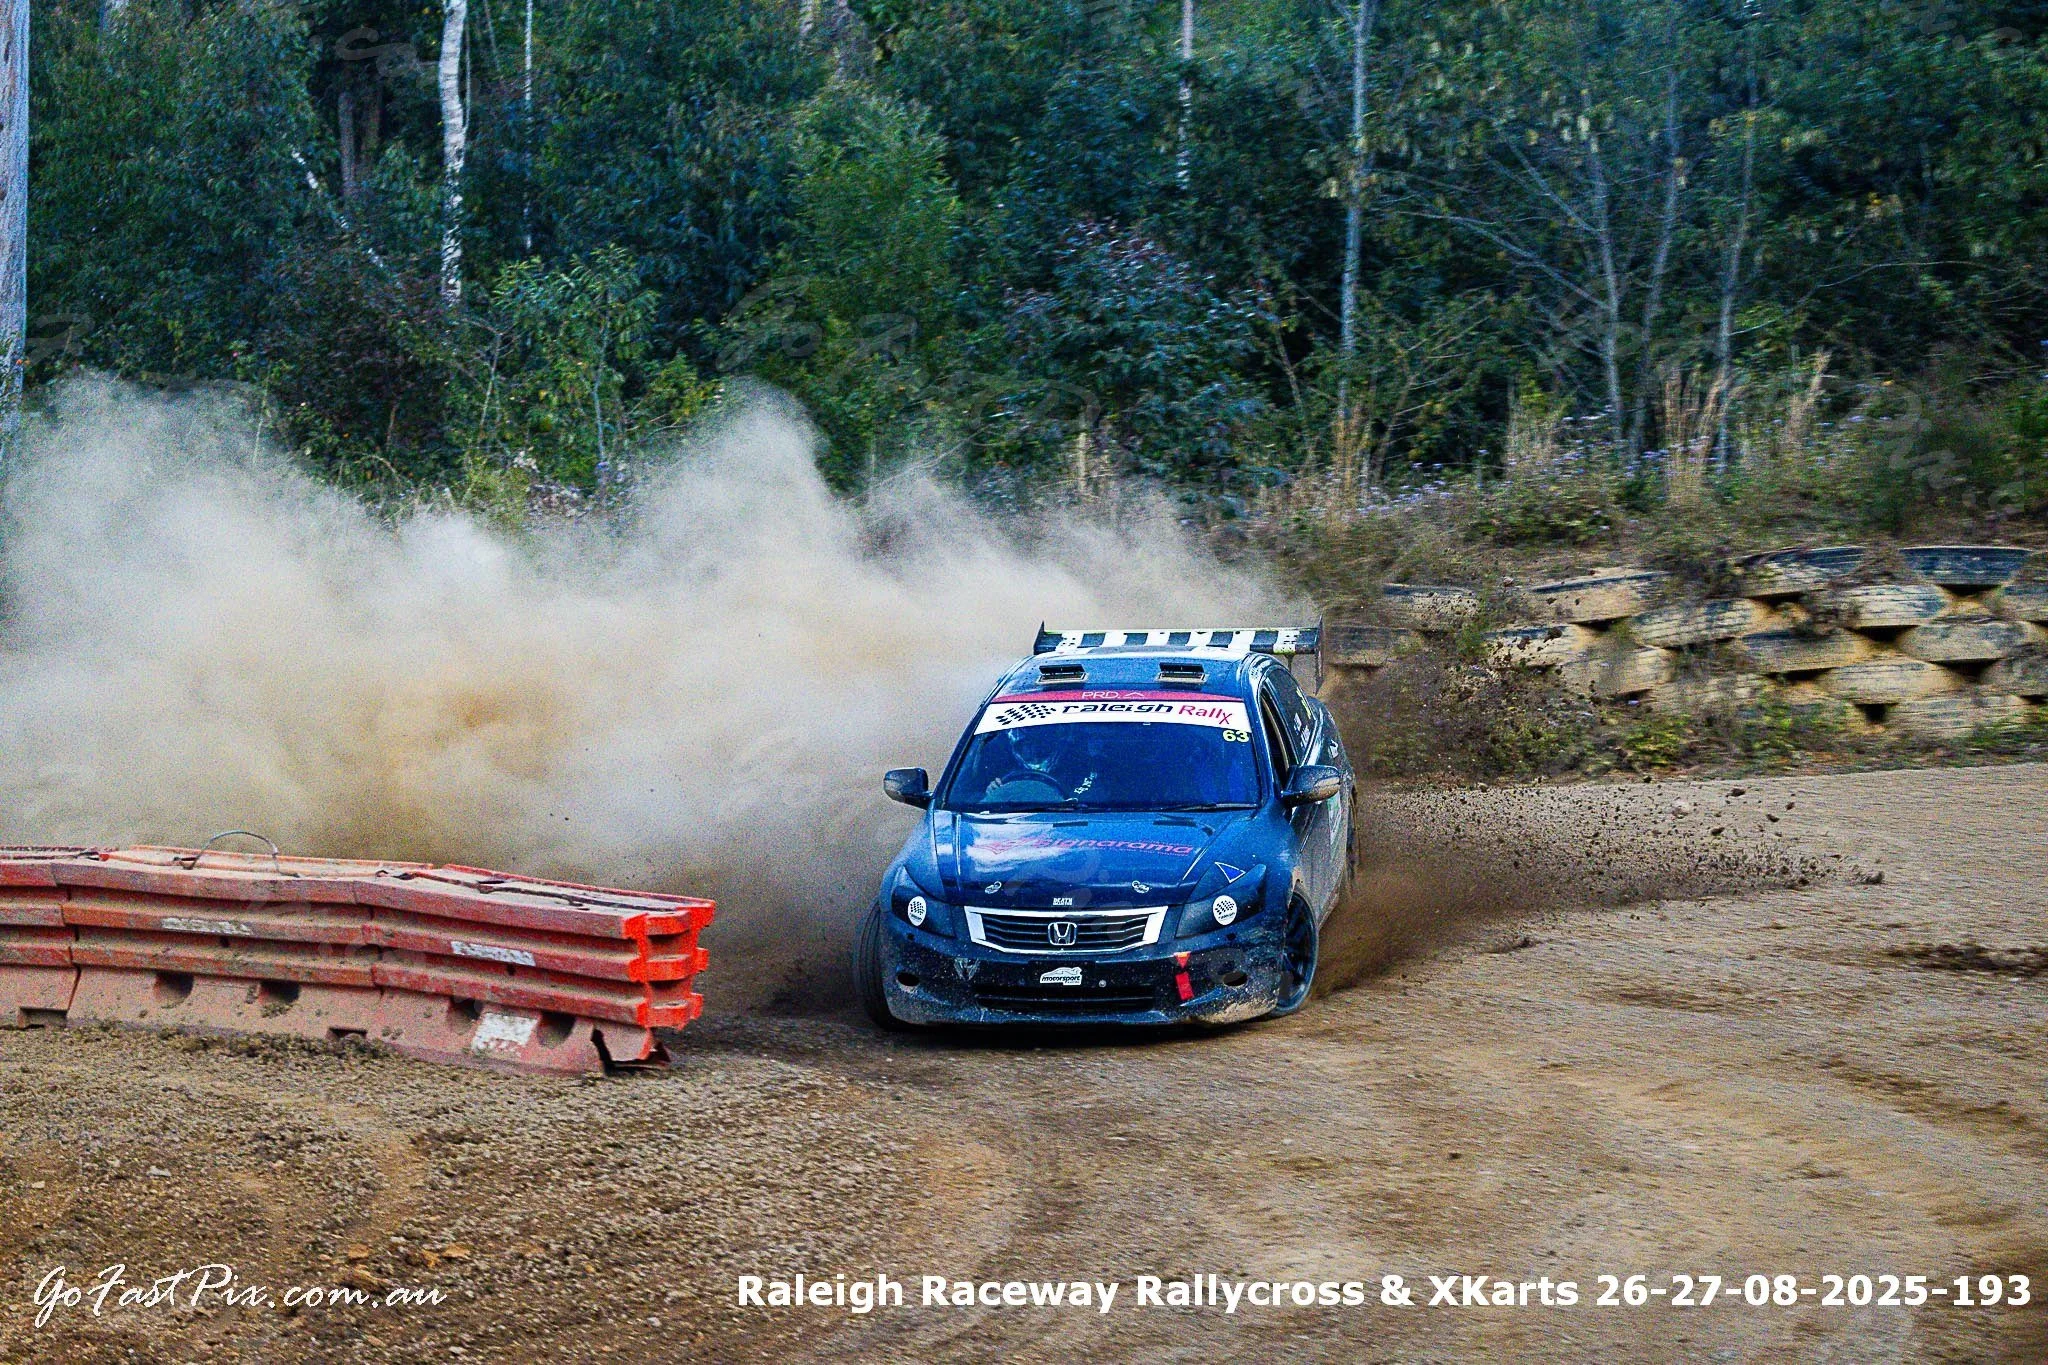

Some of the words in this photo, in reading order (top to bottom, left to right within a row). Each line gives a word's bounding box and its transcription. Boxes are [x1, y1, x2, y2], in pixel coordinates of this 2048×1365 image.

[1062, 703, 1174, 714] raleigh
[1222, 729, 1250, 743] 63
[1041, 975, 1081, 983] motorsport
